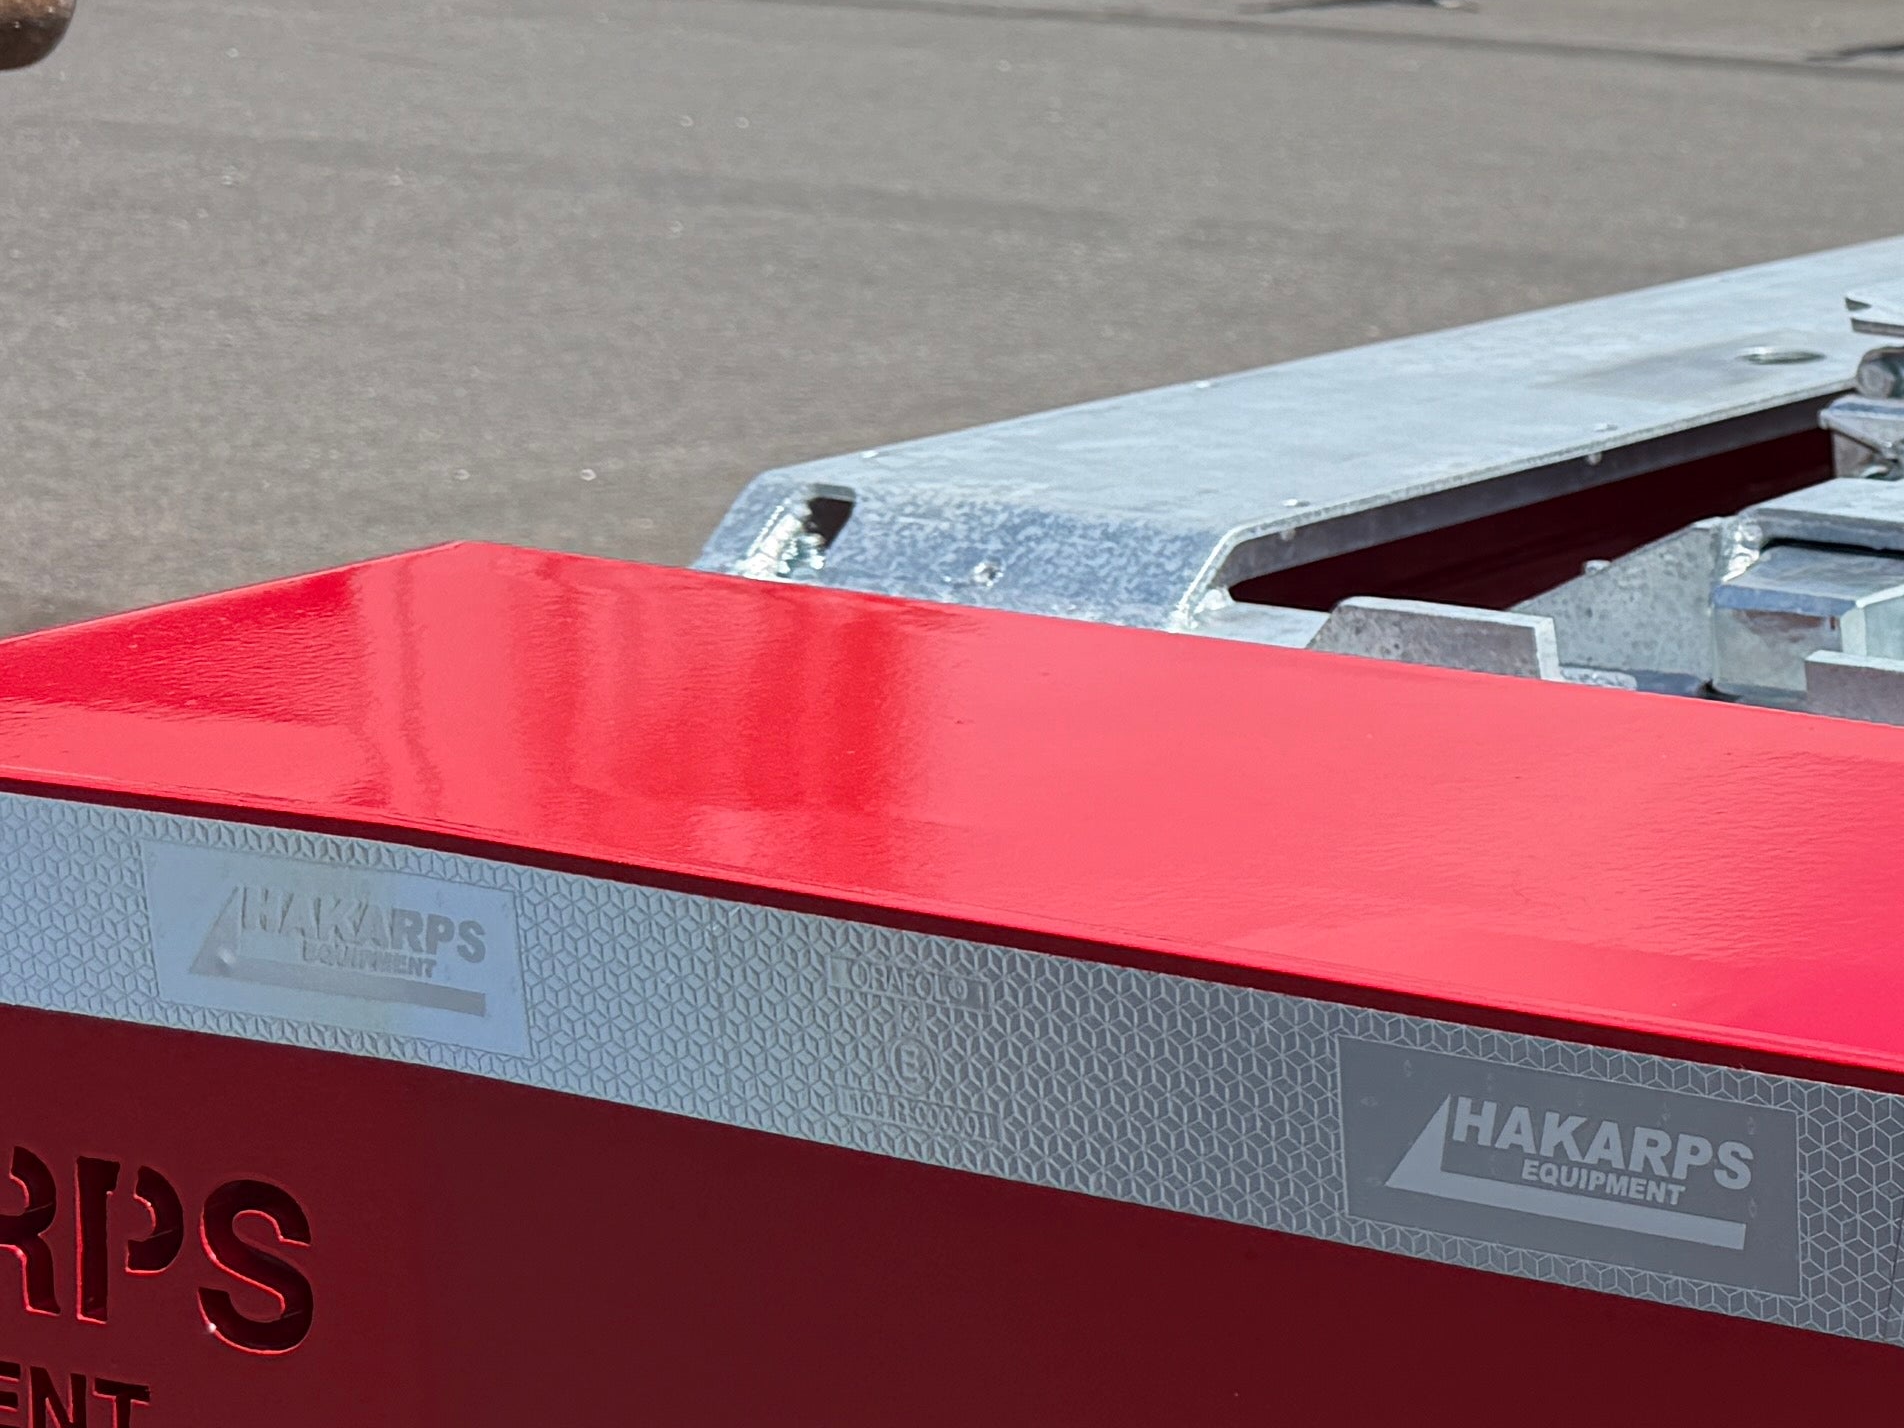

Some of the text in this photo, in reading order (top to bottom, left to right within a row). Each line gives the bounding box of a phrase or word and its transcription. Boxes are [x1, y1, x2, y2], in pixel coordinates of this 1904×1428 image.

[241, 886, 487, 964] HAKARPS
[302, 938, 437, 979] EQUIPMENT
[1451, 1094, 1755, 1190] HAKARPS
[1521, 1158, 1686, 1206] EQUIPMENT
